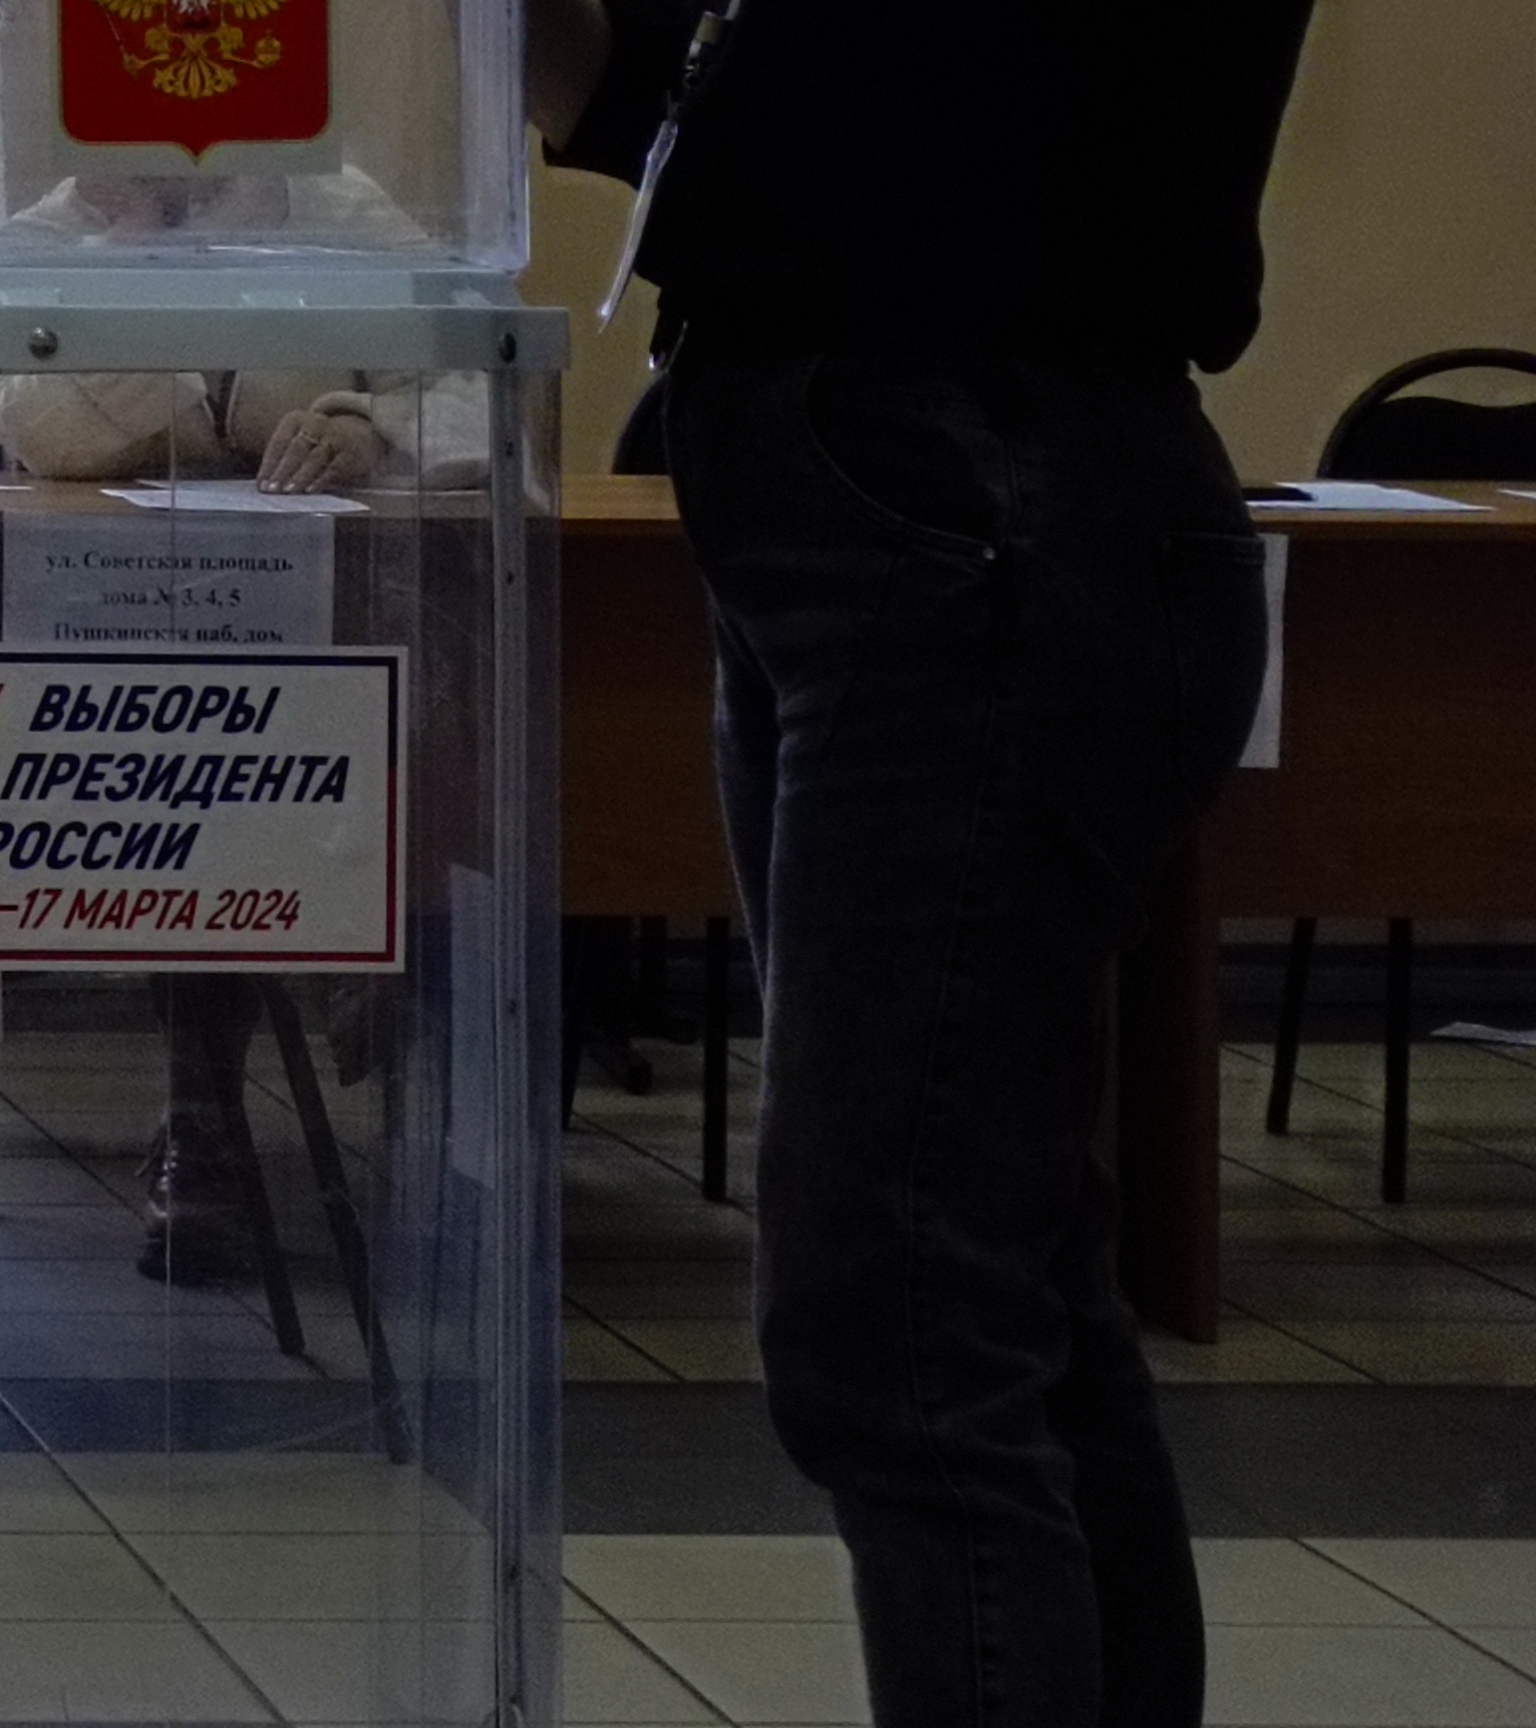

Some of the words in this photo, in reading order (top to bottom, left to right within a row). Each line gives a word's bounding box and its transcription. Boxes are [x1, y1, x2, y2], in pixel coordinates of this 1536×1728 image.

[83, 551, 193, 570] Советская
[199, 557, 294, 572] площадь
[29, 684, 281, 734] ВЫБОРЫ
[0, 753, 350, 810] ПРЕЗИДЕНТА
[64, 888, 199, 931] МАРТА
[205, 889, 302, 932] 2024
